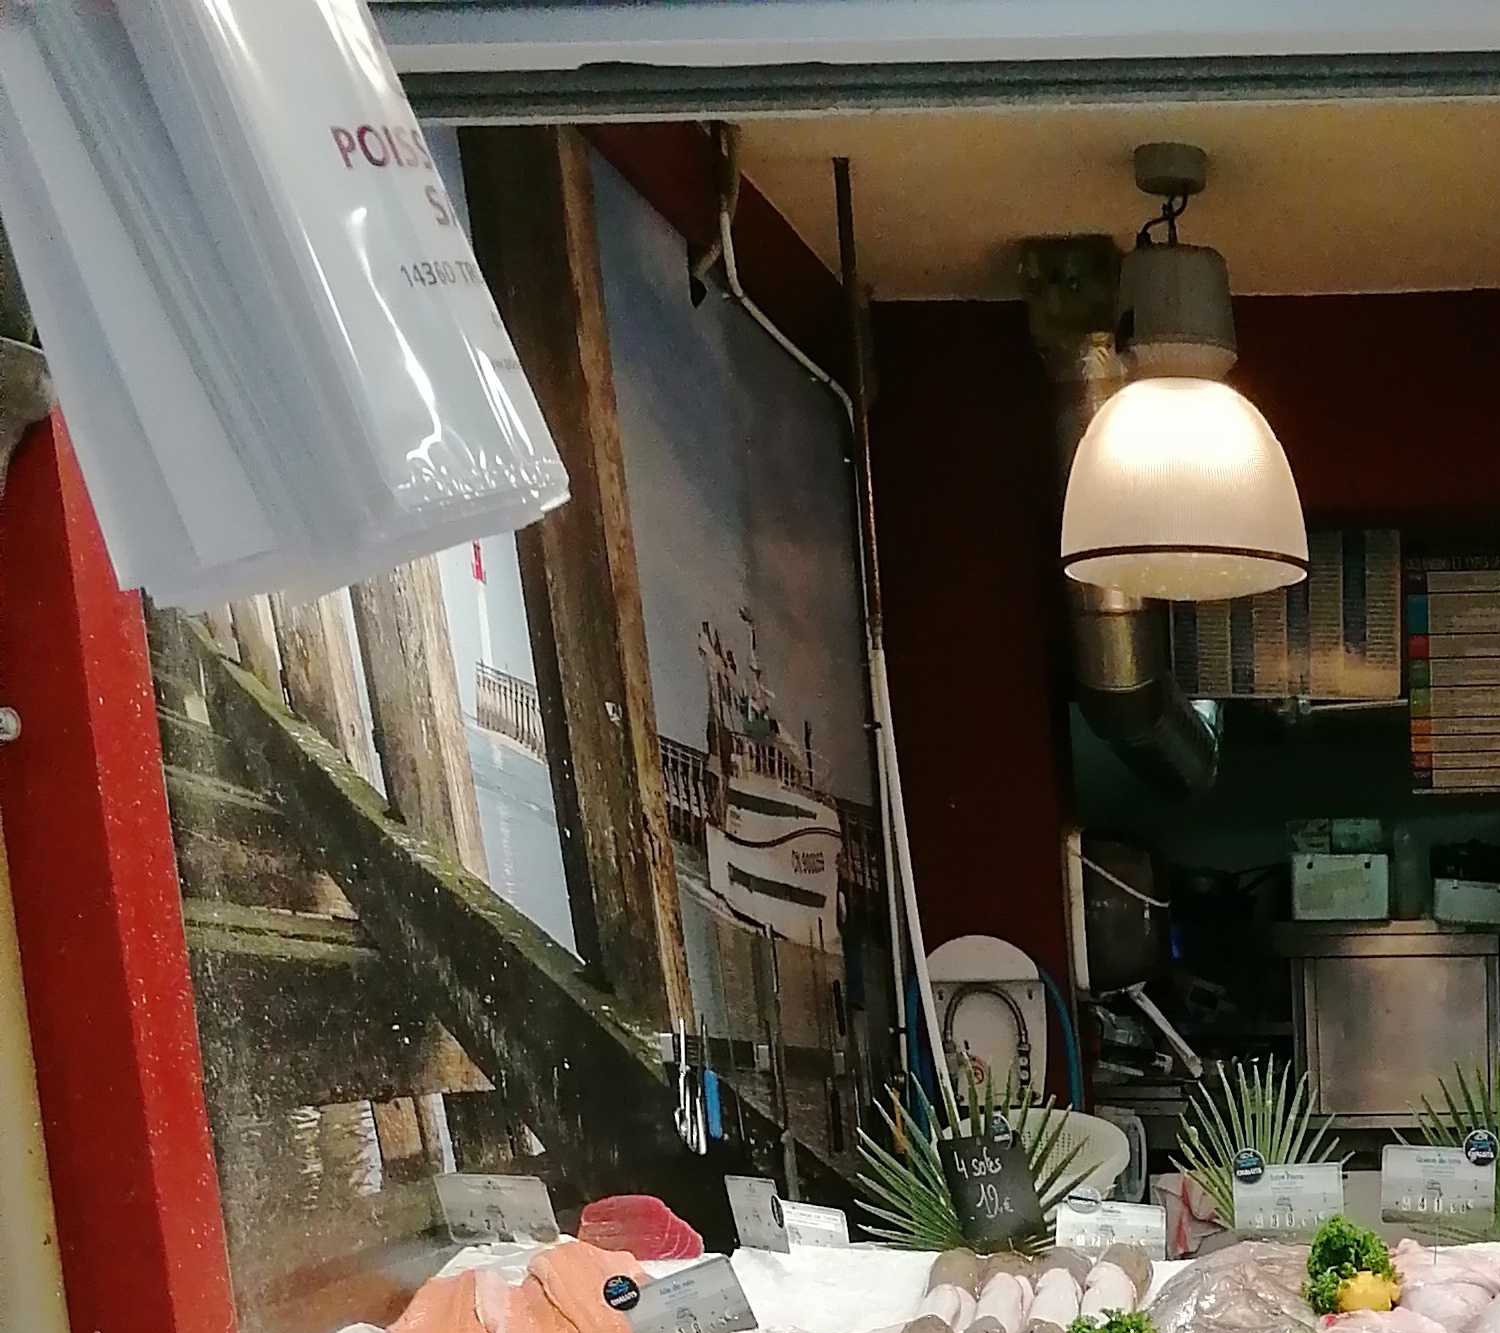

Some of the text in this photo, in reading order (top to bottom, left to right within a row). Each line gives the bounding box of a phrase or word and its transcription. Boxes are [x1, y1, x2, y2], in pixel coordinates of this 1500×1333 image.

[424, 184, 457, 226] S
[953, 1146, 1003, 1180] 4 soles
